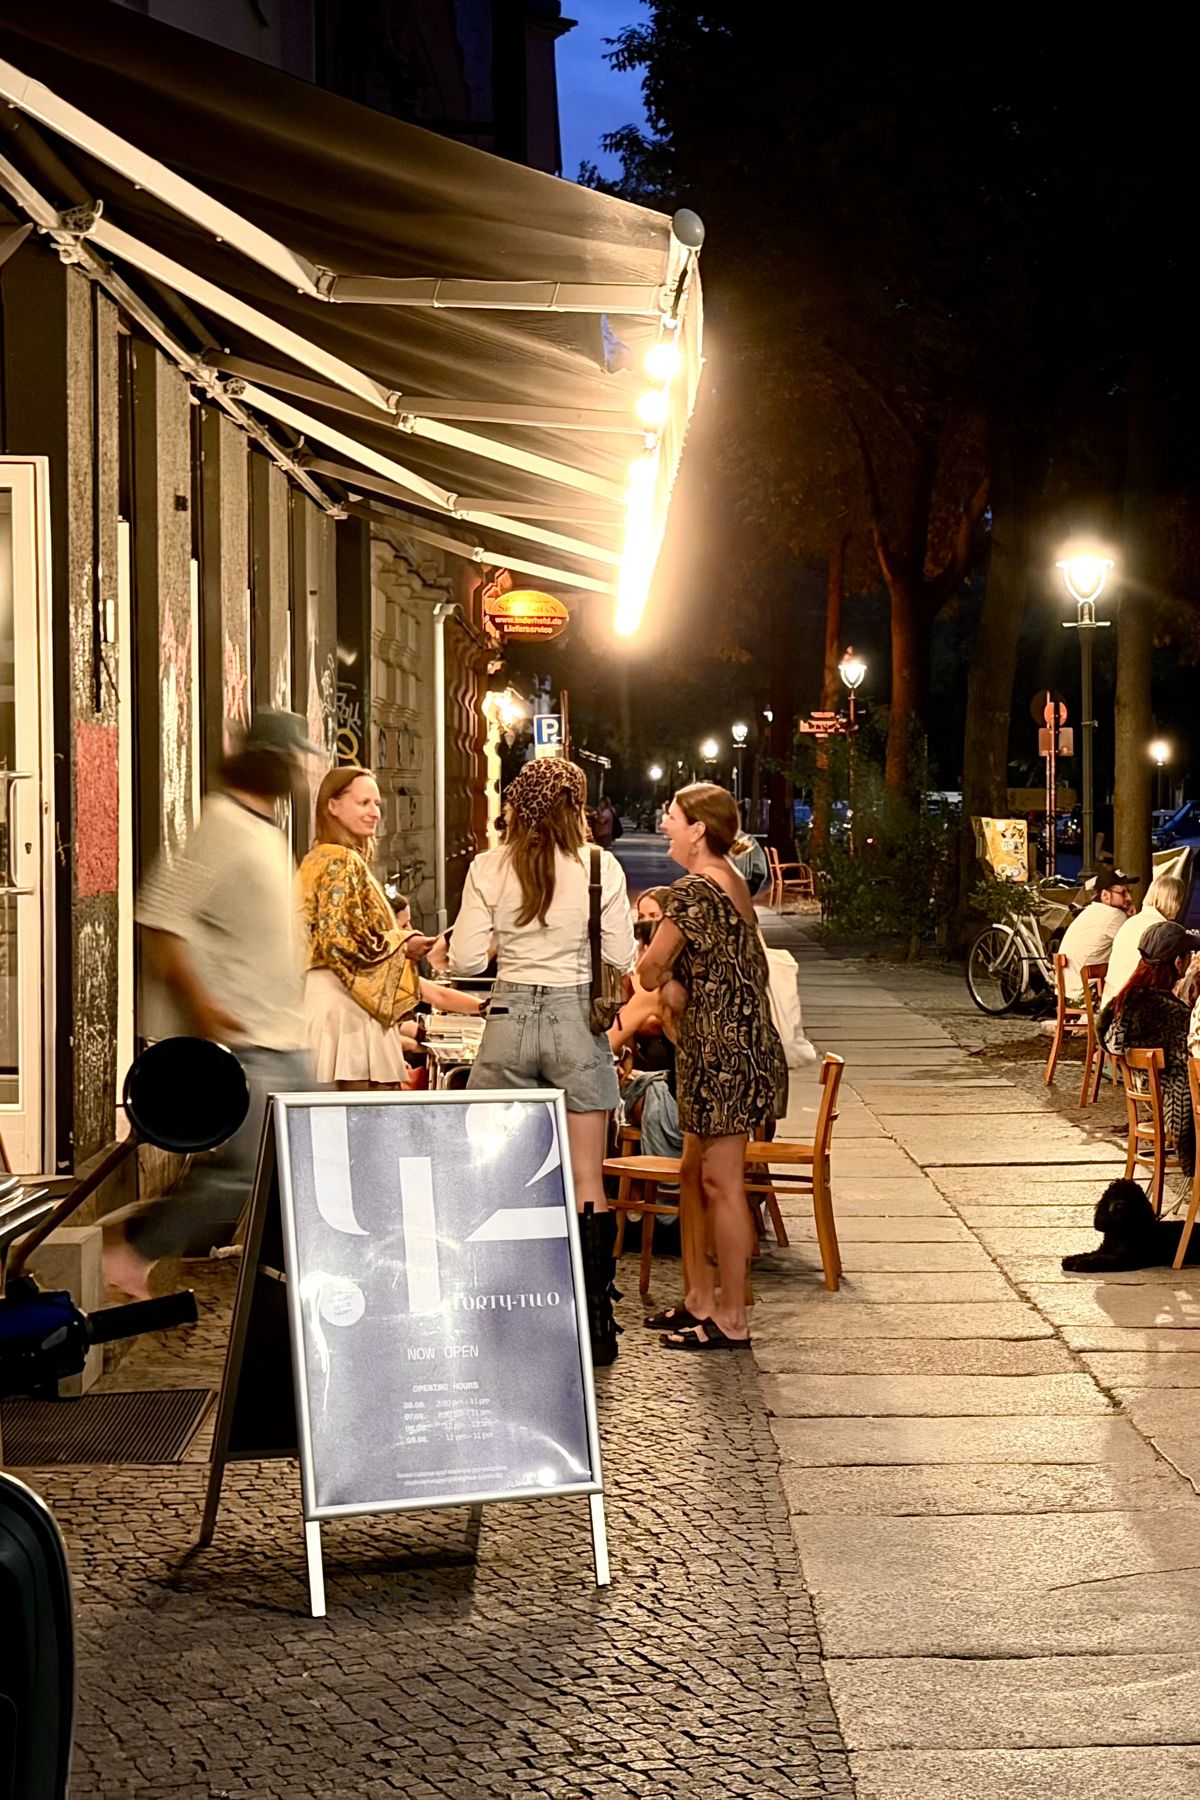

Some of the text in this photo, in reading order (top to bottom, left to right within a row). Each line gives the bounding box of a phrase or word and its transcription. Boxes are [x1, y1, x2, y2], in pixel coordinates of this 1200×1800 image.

[542, 718, 559, 743] P
[453, 1291, 560, 1311] FORTY-TWO
[407, 1345, 479, 1360] NOW OPEN
[413, 1381, 479, 1392] OPENING HOURS
[470, 1397, 478, 1405] 11
[479, 1398, 490, 1406] pm
